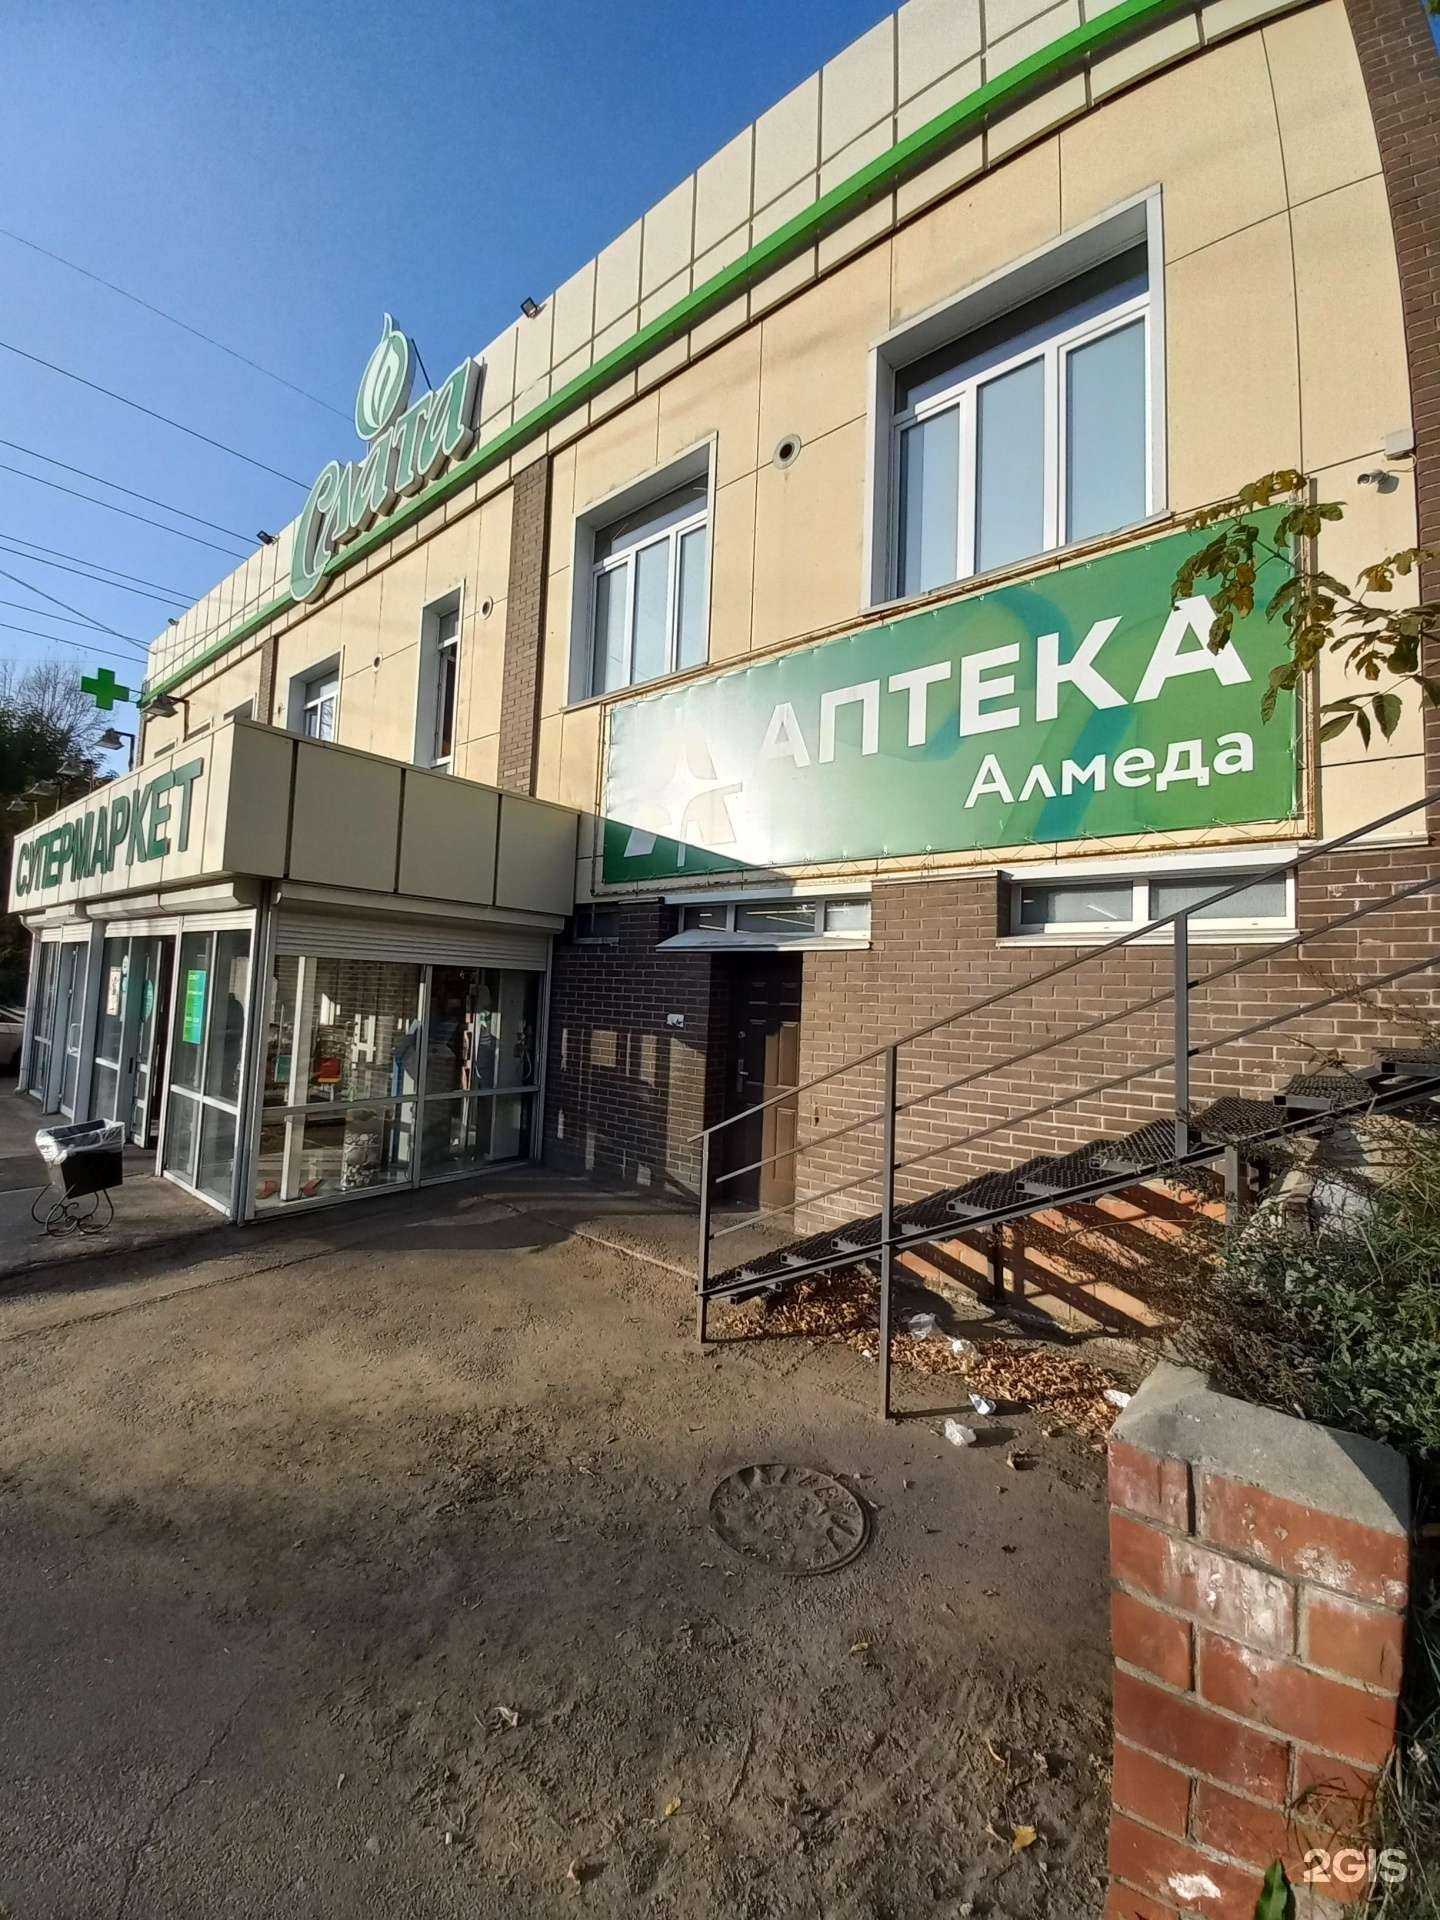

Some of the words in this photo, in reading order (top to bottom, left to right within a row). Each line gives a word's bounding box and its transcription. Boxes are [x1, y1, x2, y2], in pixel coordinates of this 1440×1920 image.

[290, 356, 476, 604] Слата
[757, 594, 1253, 768] АПТЕКА
[15, 757, 204, 898] СУПЕРМАРКЕТ
[963, 730, 1256, 809] Алмеда
